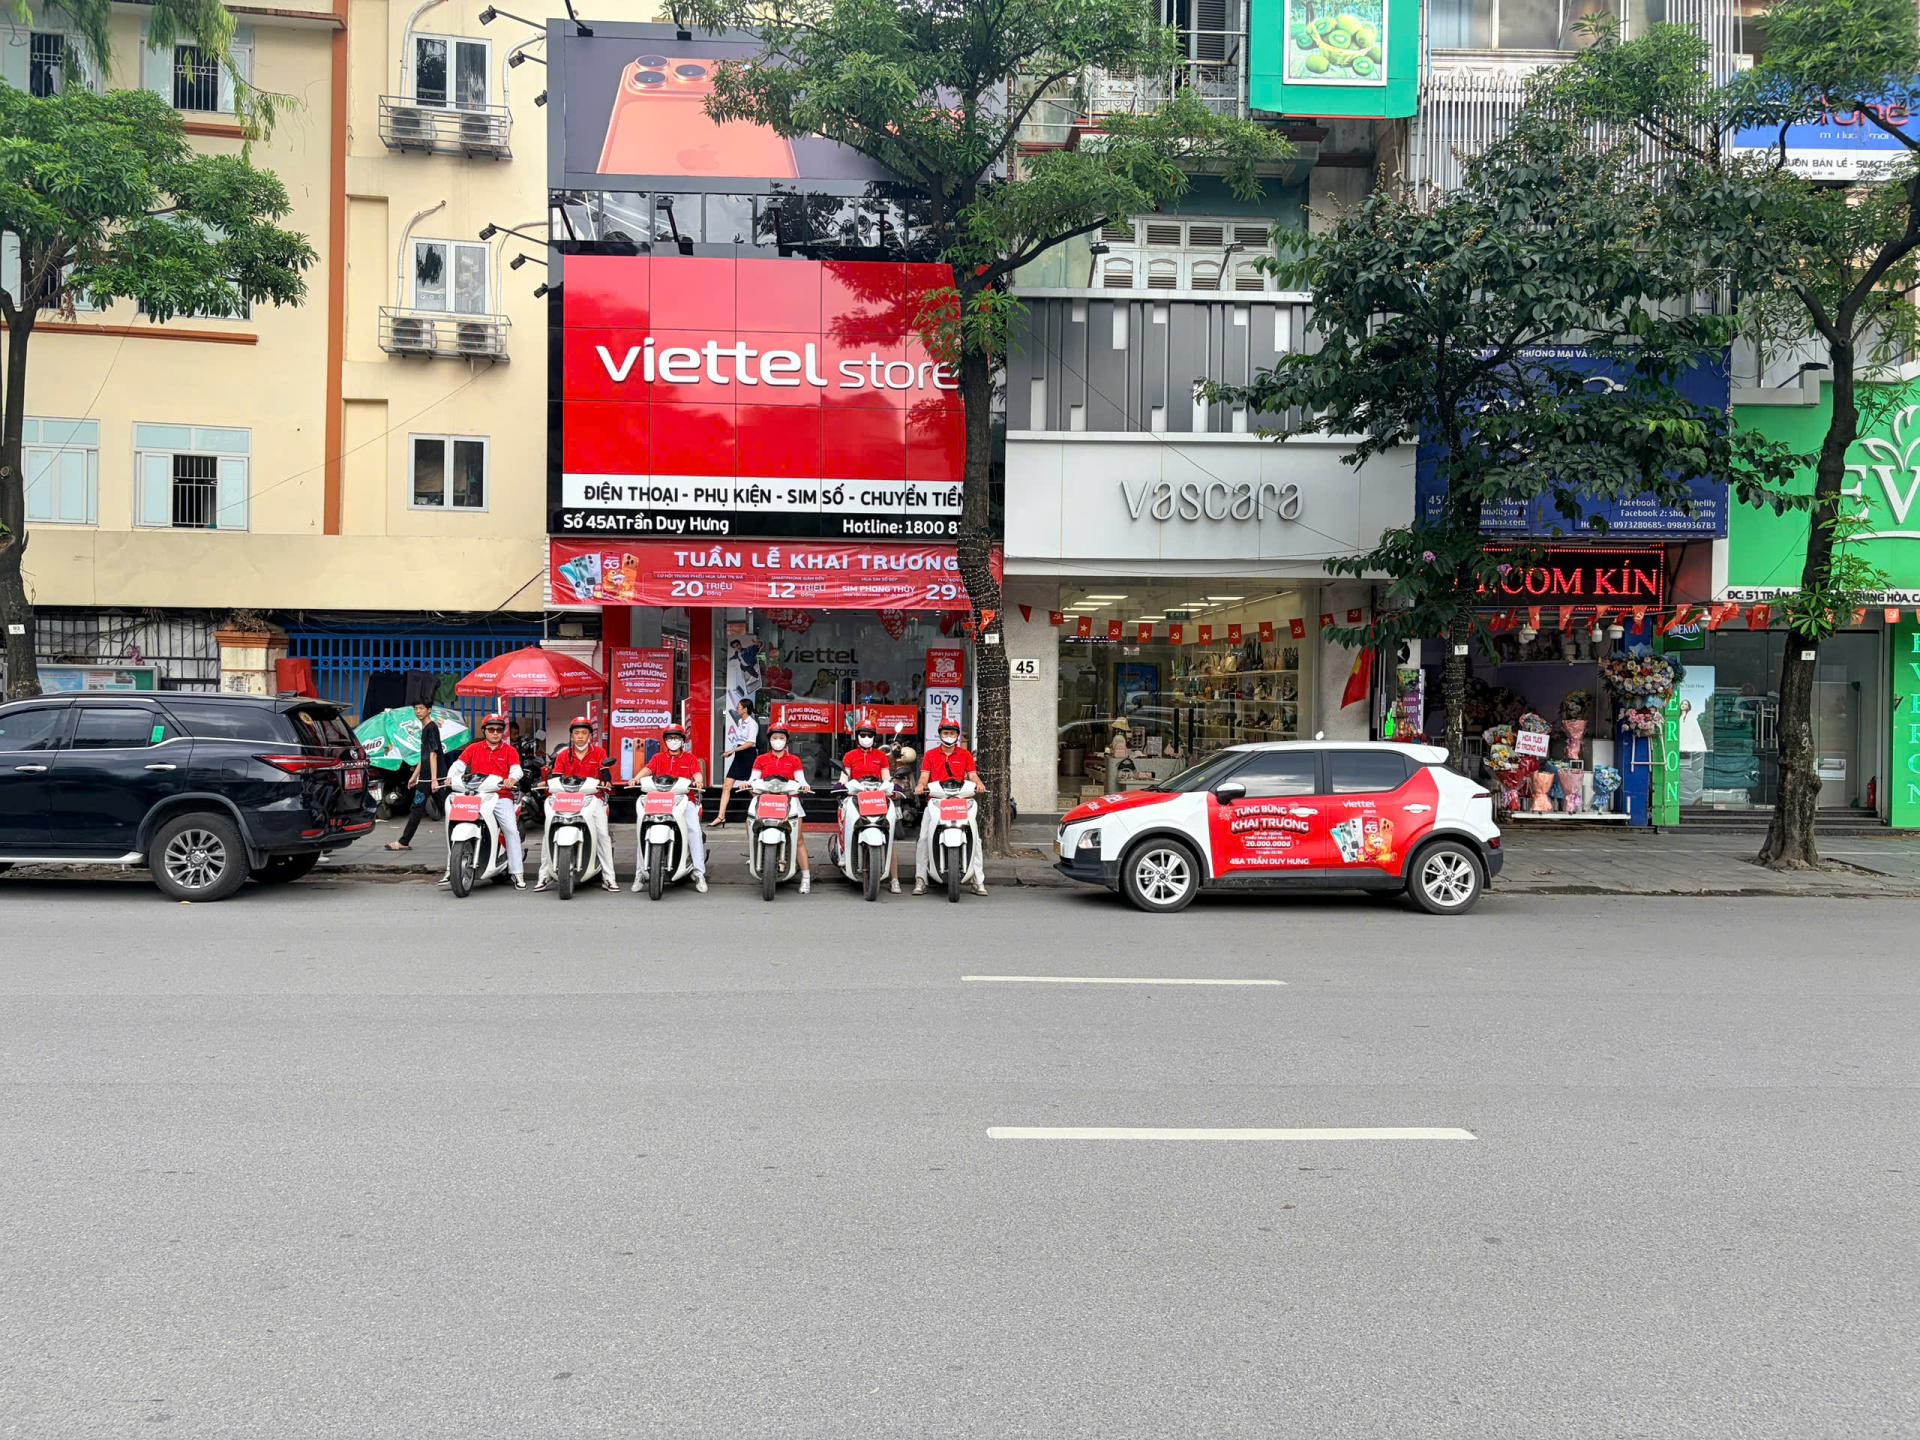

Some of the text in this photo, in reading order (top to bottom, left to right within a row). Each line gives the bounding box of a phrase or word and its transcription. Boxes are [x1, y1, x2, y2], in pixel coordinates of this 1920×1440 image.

[1812, 158, 1833, 168] BÁN
[1557, 348, 1573, 360] MẠI
[1574, 346, 1588, 358] VÀ
[595, 337, 960, 390] viettel store
[584, 481, 623, 505] ĐIỆN
[628, 486, 679, 506] THOẠI
[694, 487, 729, 507] PHỤ
[733, 484, 772, 507] KIỆN
[787, 488, 817, 506] SIM
[822, 483, 845, 506] SỐ
[860, 484, 927, 507] CHUYỂN
[1120, 480, 1303, 521] vascara
[1619, 499, 1656, 507] Facebook
[1621, 509, 1658, 517] Facebook
[563, 511, 585, 529] Số
[656, 515, 686, 534] Duy
[690, 515, 729, 535] Hưng
[842, 518, 962, 535] Hotline: 1800 8
[1667, 521, 1716, 530] 0984936783
[673, 545, 960, 571] TUẦN LỄ KHAI TRƯƠNG
[1593, 559, 1659, 596] KÍN
[671, 580, 704, 597] 20
[767, 581, 796, 598] 12
[842, 585, 858, 593] SIM
[859, 585, 891, 593] PHONG
[925, 583, 957, 601] 29
[1727, 590, 1745, 600] ĐC:
[1746, 591, 1759, 600] 51
[784, 646, 858, 664] viettel
[1016, 661, 1034, 674] 45
[614, 715, 669, 724] 35.990.000đ
[1234, 804, 1287, 817] TƯNG BỪNG
[1342, 800, 1376, 808] viettel
[1231, 817, 1309, 832] KHAI TRƯƠNG
[1246, 856, 1268, 865] TRẦN
[1269, 857, 1286, 865] DUY
[1287, 857, 1310, 865] HƯNG
